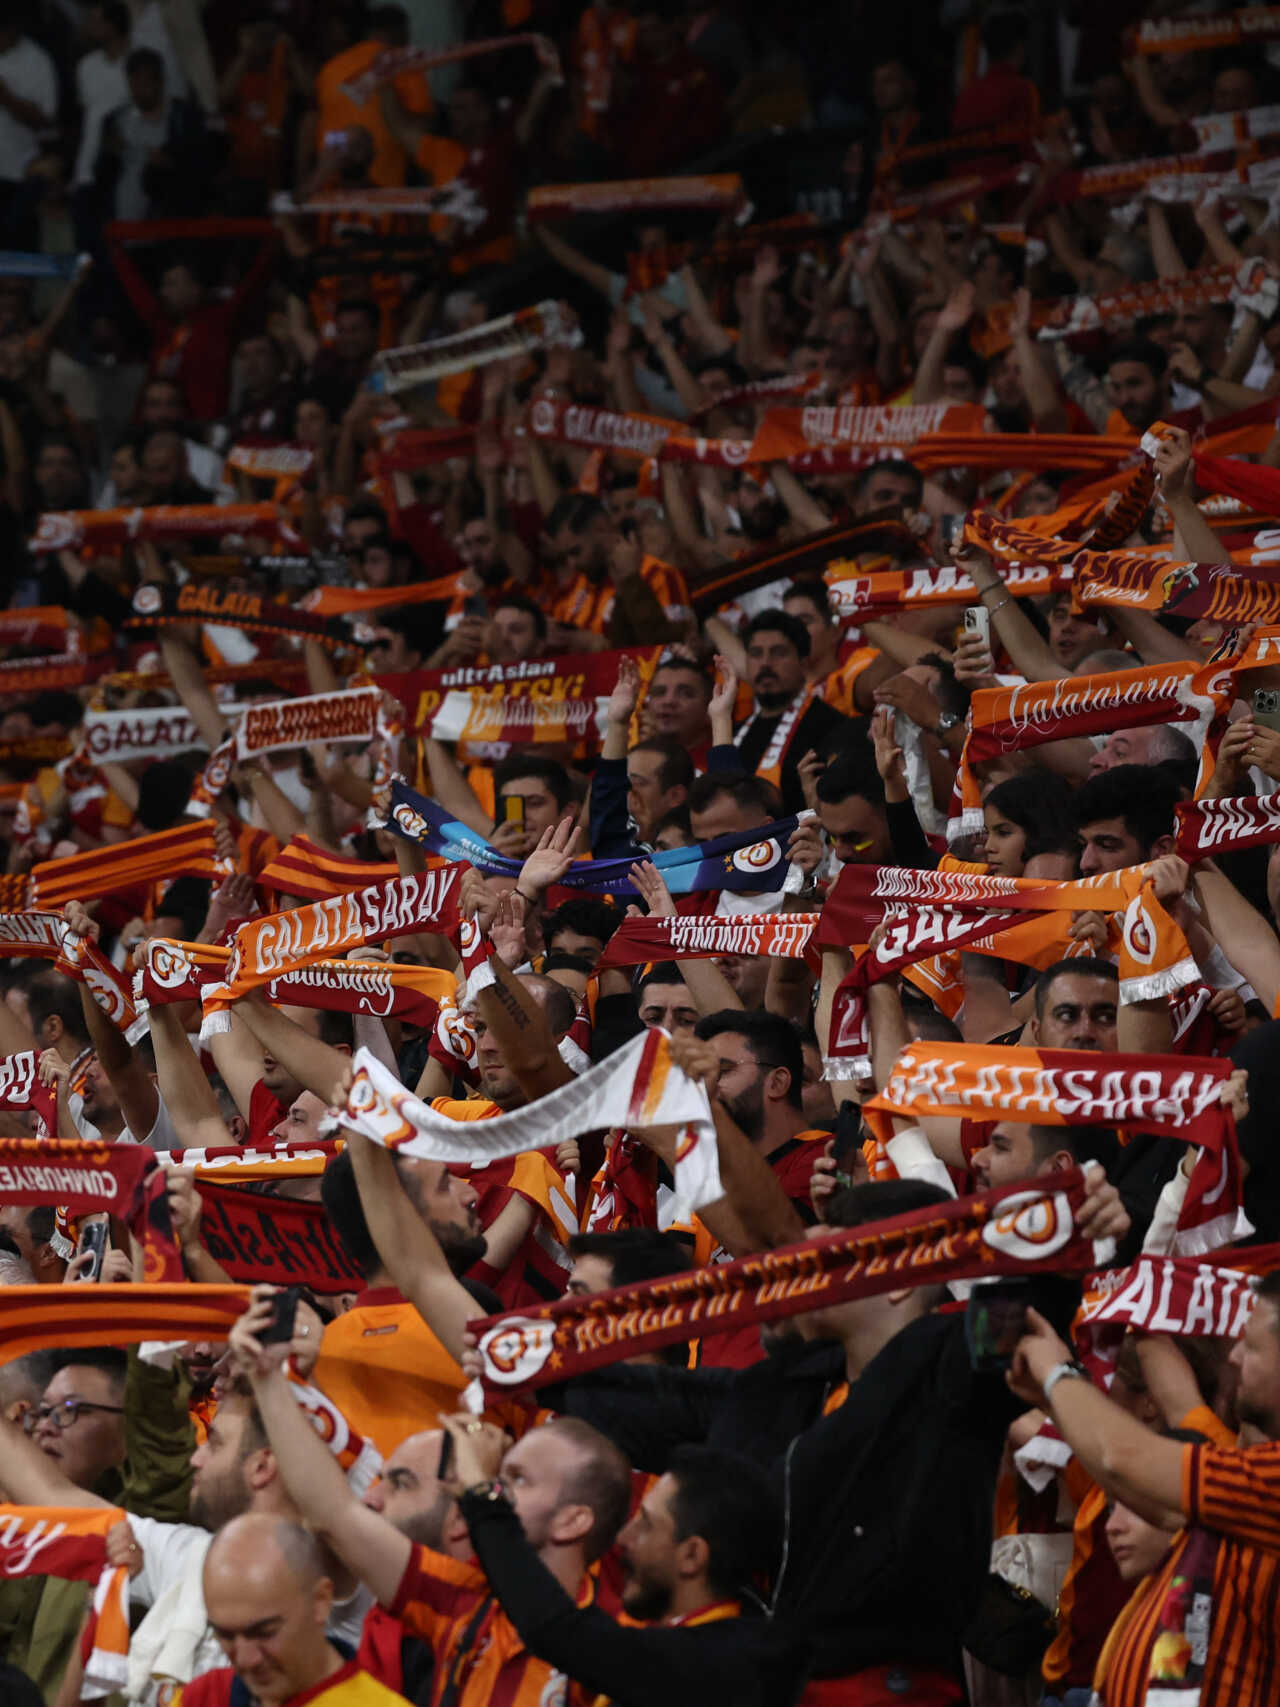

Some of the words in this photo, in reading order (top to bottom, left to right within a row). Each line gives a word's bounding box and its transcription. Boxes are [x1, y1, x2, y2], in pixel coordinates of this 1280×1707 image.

[901, 561, 1051, 599] Mein
[255, 867, 459, 975] GALATASARAY
[882, 1057, 1224, 1128] GALATASARAY
